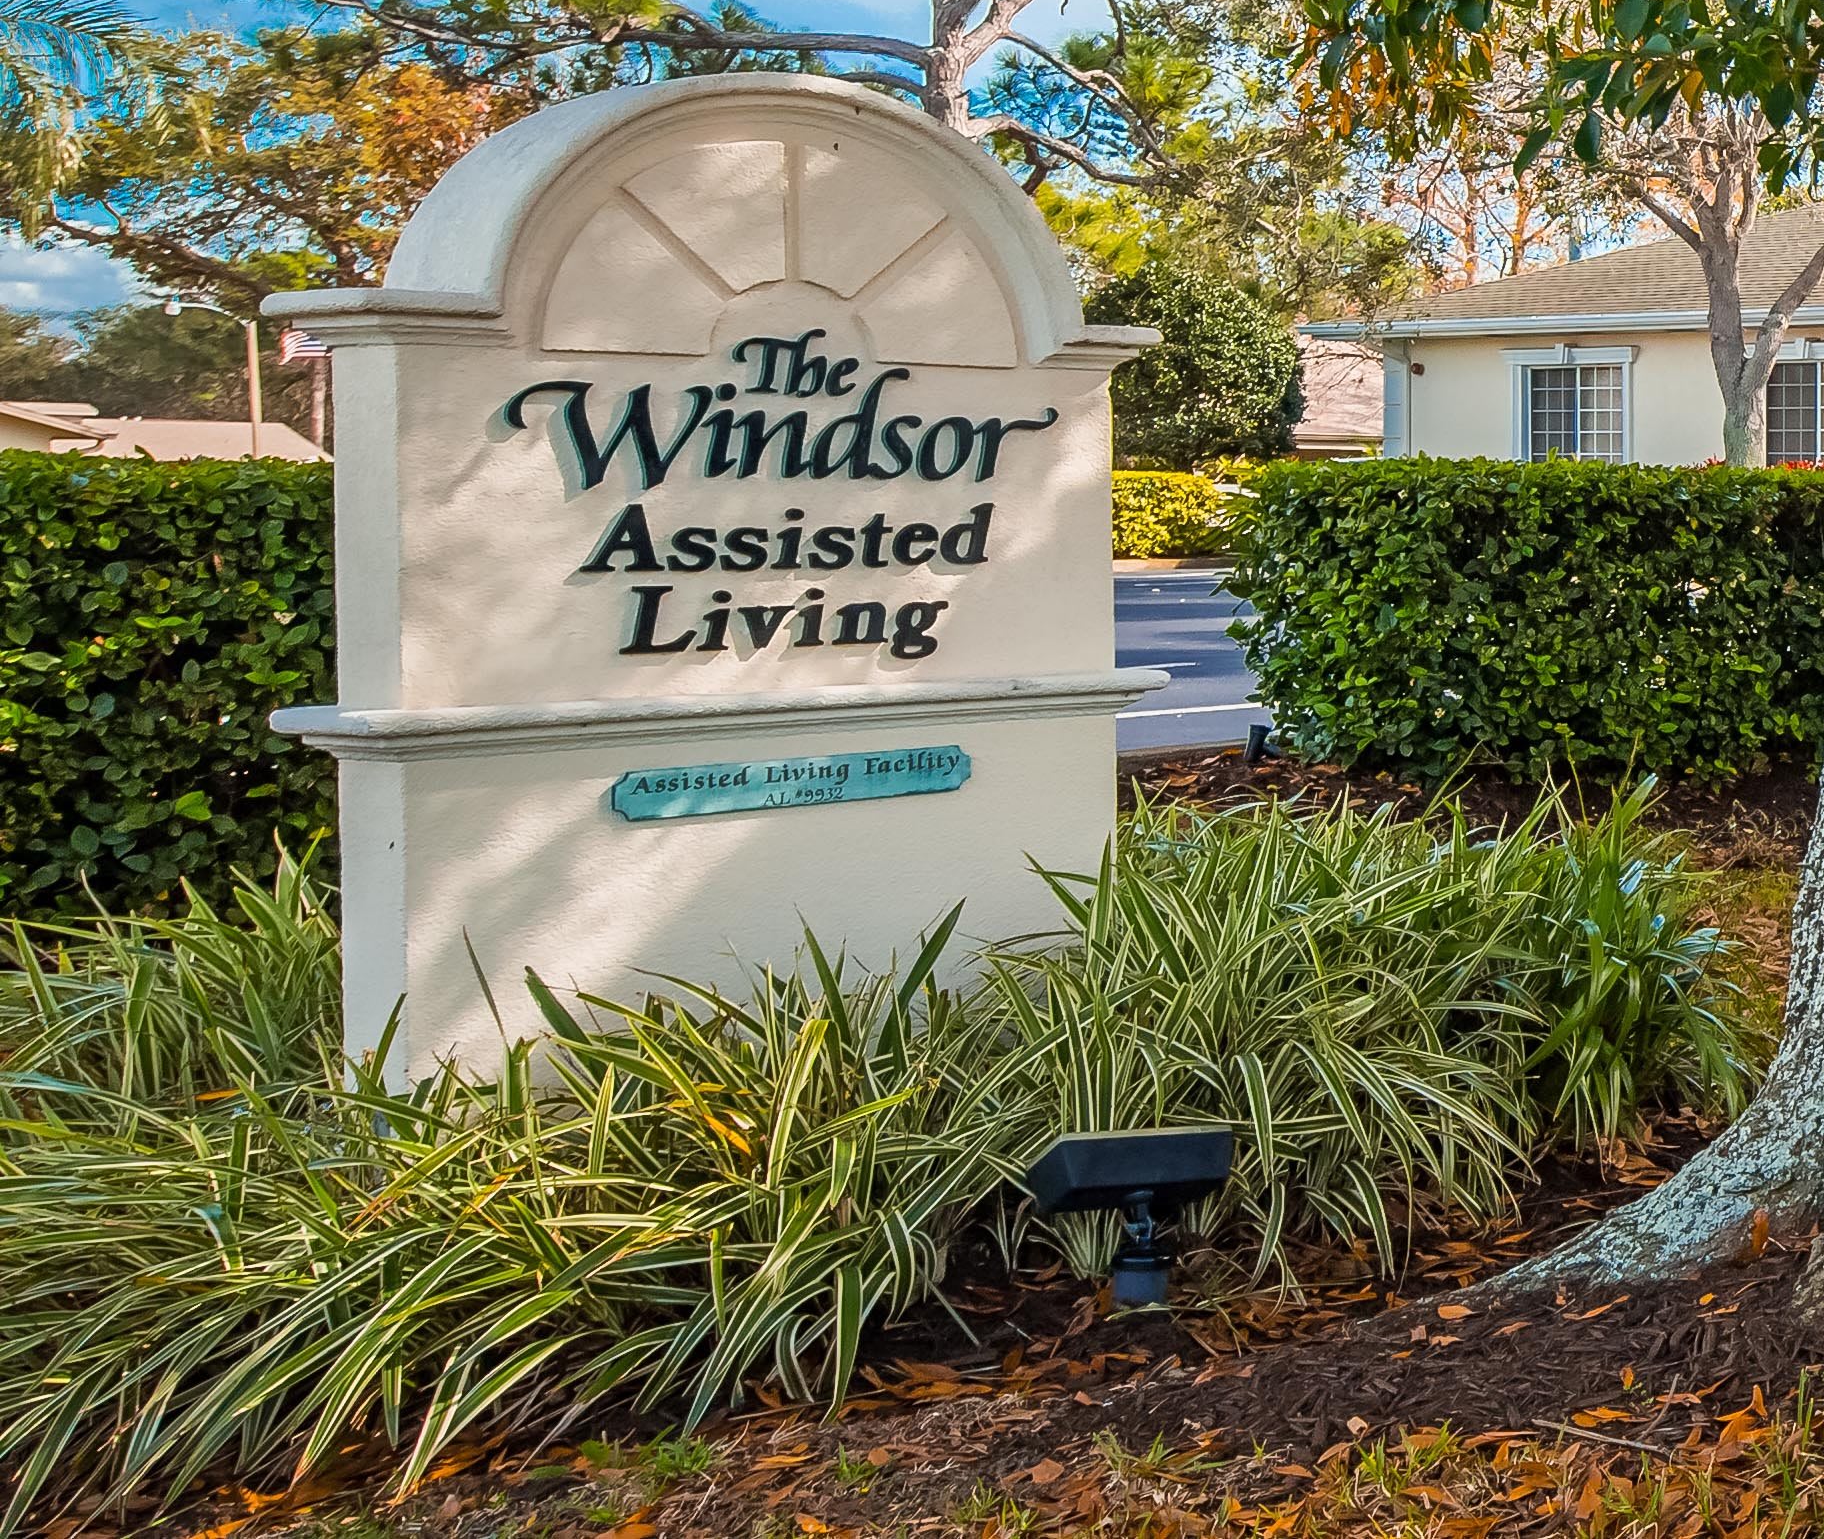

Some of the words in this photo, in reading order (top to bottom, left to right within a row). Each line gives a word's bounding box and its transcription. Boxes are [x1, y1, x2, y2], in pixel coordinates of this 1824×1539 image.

[732, 329, 860, 399] The
[506, 367, 1060, 490] Windsor
[581, 502, 993, 573] Assisted
[619, 582, 950, 660] Living
[631, 765, 750, 795] Assisted
[764, 762, 850, 786] Living
[863, 750, 961, 778] Facility
[763, 790, 791, 808] AL
[794, 785, 845, 804] #9932
